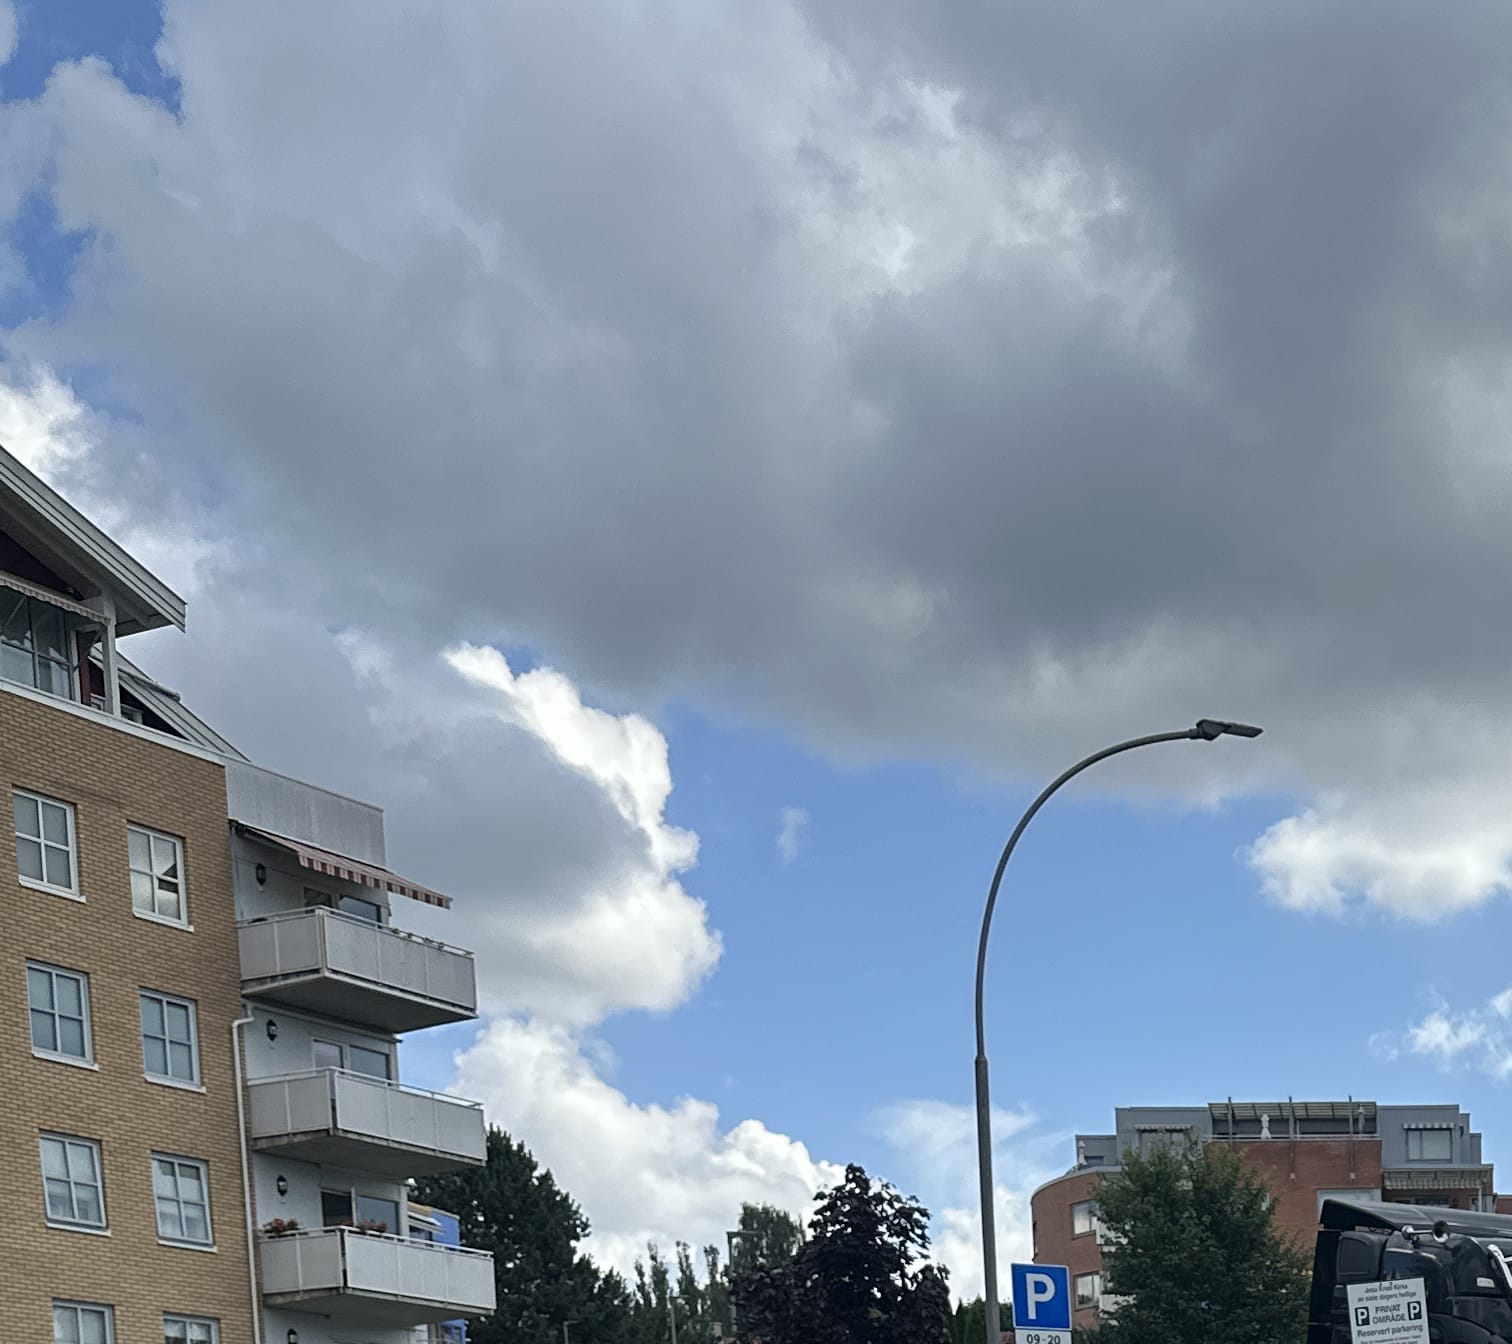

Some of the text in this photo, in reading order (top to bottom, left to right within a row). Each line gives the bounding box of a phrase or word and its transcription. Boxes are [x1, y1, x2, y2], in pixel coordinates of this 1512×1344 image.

[1026, 1273, 1055, 1319] P
[1375, 1304, 1401, 1314] PRIVAT
[1409, 1302, 1420, 1319] P
[1356, 1308, 1368, 1325] P
[1372, 1312, 1406, 1324] OMRÅDE
[1357, 1325, 1423, 1337] Reservert parkering
